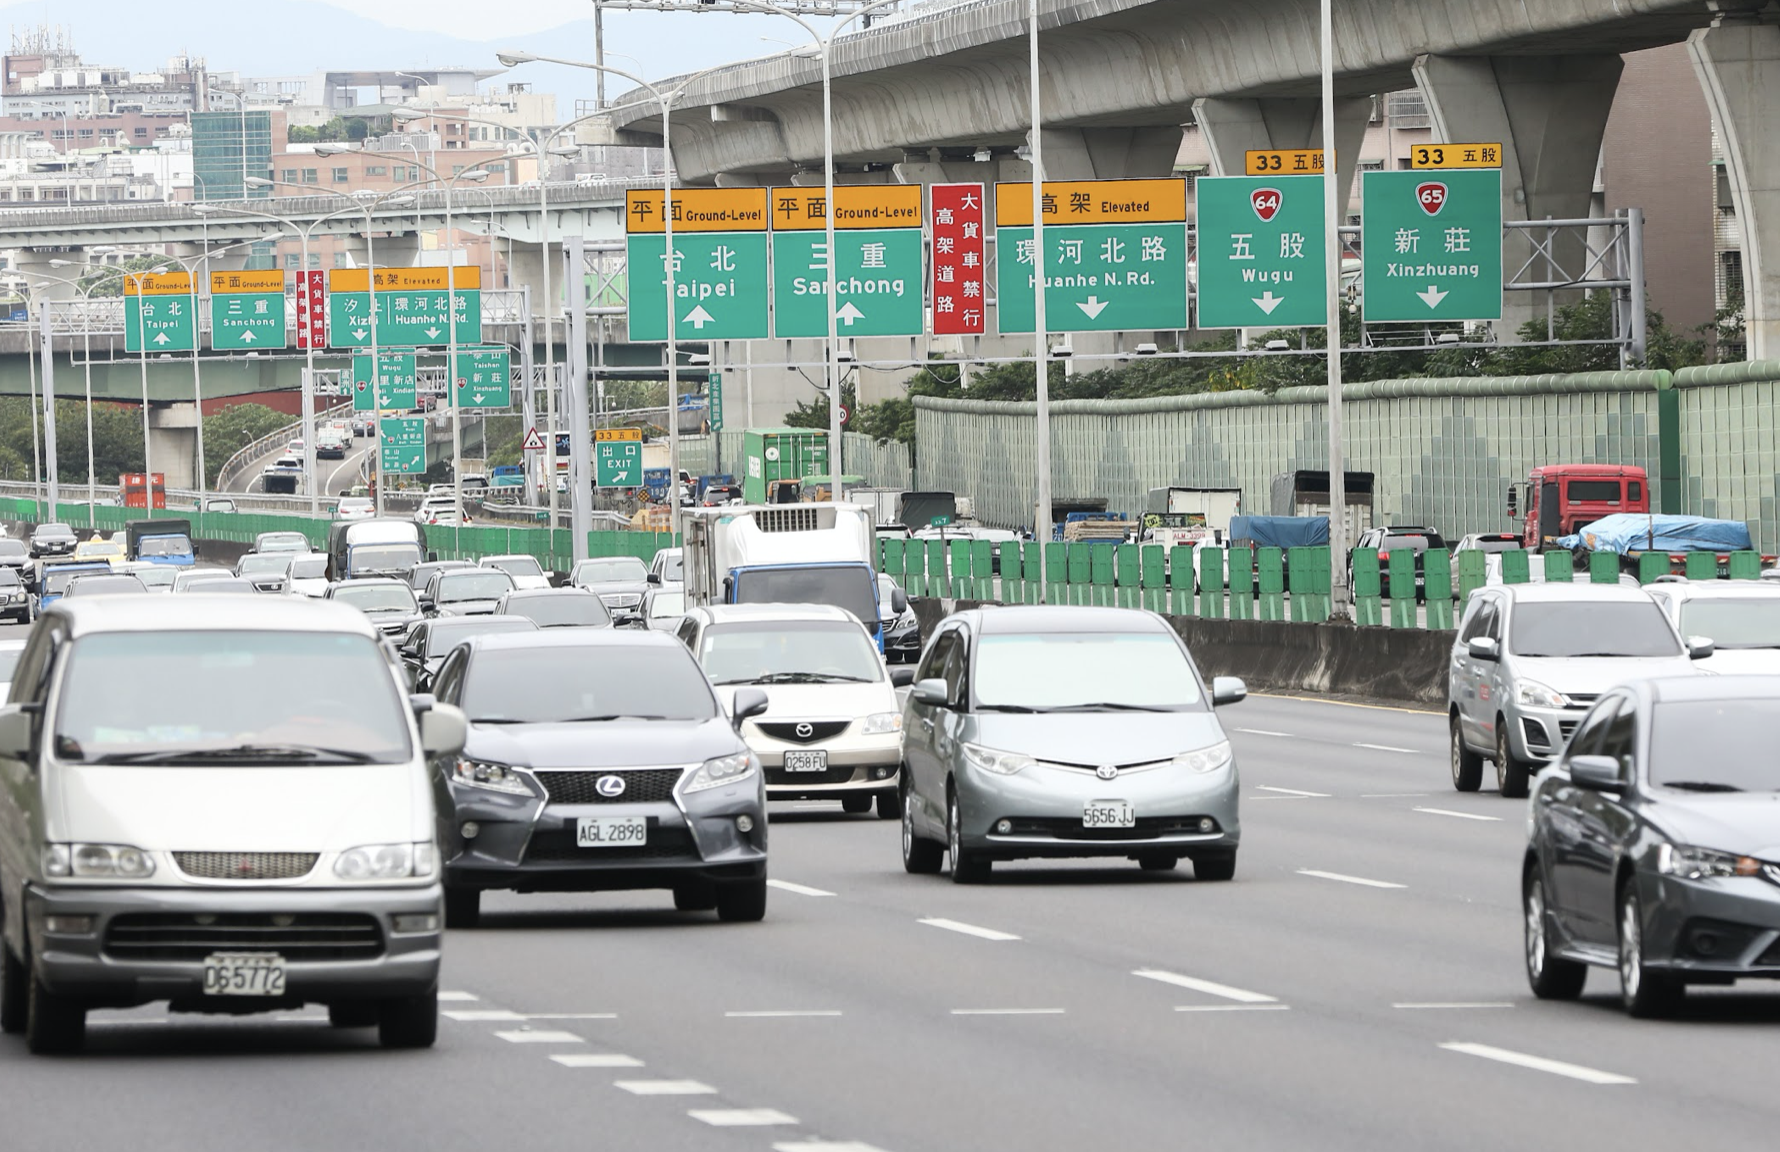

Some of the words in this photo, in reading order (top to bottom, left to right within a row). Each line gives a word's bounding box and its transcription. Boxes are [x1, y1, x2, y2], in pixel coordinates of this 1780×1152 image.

[1256, 155, 1282, 170] 33
[1293, 154, 1325, 170] 五股
[1416, 148, 1444, 165] 33
[1462, 148, 1496, 162] 五股
[1041, 192, 1091, 214] 高架
[1101, 201, 1149, 213] Elevated
[1255, 195, 1277, 209] 64
[1421, 189, 1443, 203] 65
[631, 200, 682, 222] 平面
[686, 209, 761, 221] Ground-Level
[778, 197, 826, 219] 平面
[835, 206, 917, 219] Ground-Level
[1229, 233, 1305, 259] 五股
[1395, 227, 1470, 254] 新莊
[809, 242, 886, 269] 三重
[1016, 235, 1167, 265] 環河北路
[659, 245, 736, 272] 台北
[936, 208, 955, 313] 高架道路
[961, 192, 980, 327] 大貨車禁行
[1242, 268, 1293, 284] Wugu
[1387, 263, 1479, 278] Xinzhuang
[214, 276, 241, 288] 平面
[373, 273, 398, 286] 高架
[1104, 272, 1122, 286] N.
[1127, 272, 1155, 286] Rd.
[662, 279, 735, 301] aipei
[142, 302, 182, 317] 台北
[228, 299, 268, 315] 三重
[313, 274, 324, 344] 大貨車禁行
[394, 296, 467, 311] 環河北路
[146, 320, 178, 330] Taipei
[223, 318, 275, 327] Sanchong
[395, 314, 436, 325] Huanhe
[439, 314, 450, 324] N.
[599, 432, 612, 440] 33
[602, 445, 636, 457] 出口
[607, 459, 632, 468] EXIT
